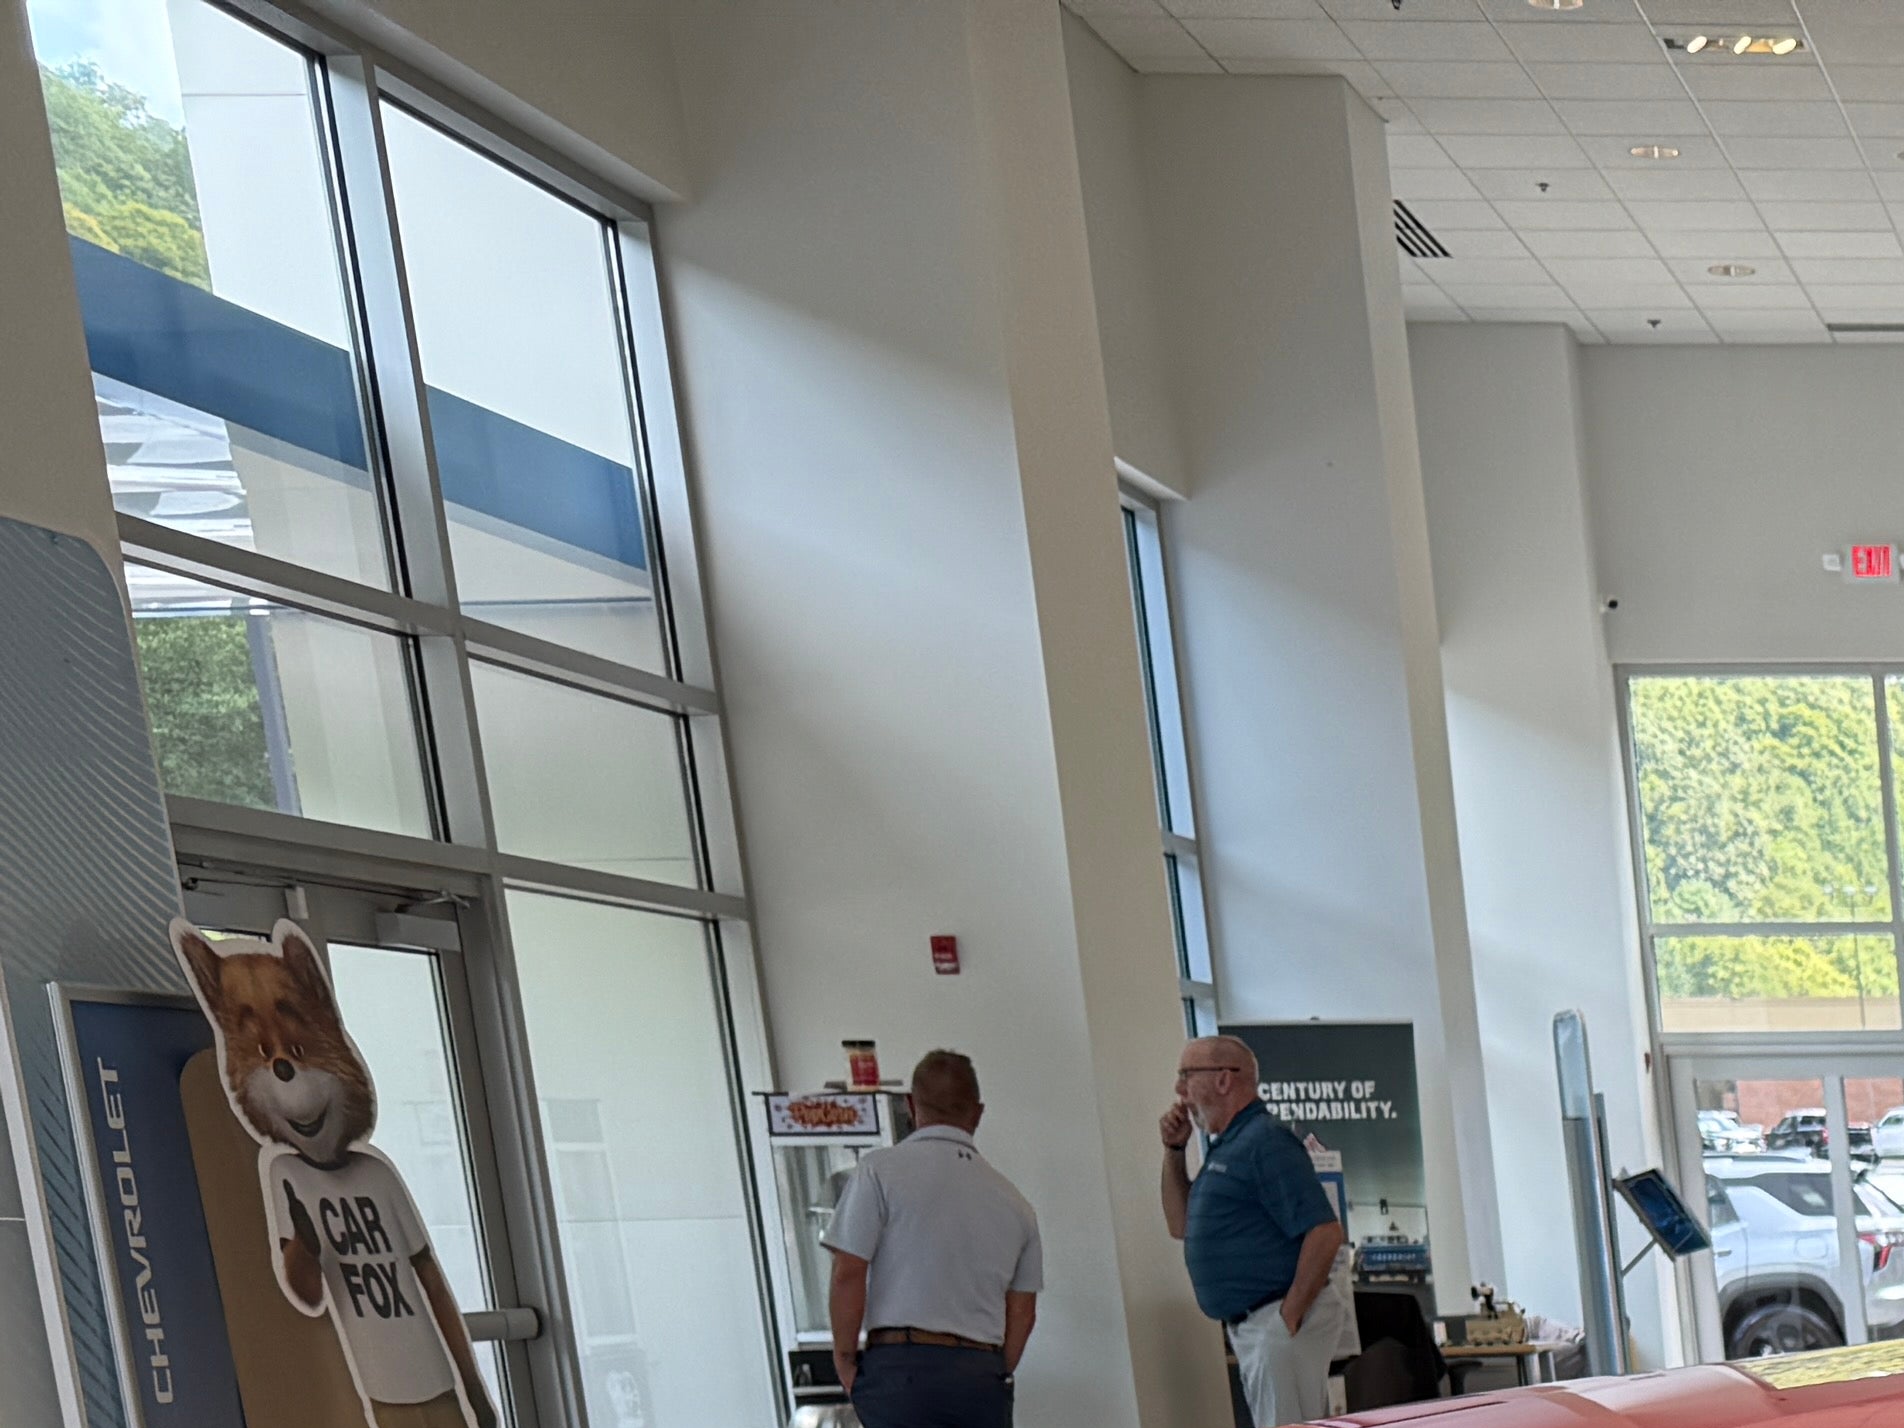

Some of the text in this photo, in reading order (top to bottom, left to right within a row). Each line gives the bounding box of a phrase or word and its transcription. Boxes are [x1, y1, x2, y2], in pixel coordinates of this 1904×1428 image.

[1257, 1080, 1376, 1101] CENTURY OF
[1266, 1101, 1398, 1121] PENDABILITY.
[97, 1057, 174, 1405] CHEVROLET
[319, 1196, 393, 1256] CAR
[339, 1261, 415, 1319] FOX
